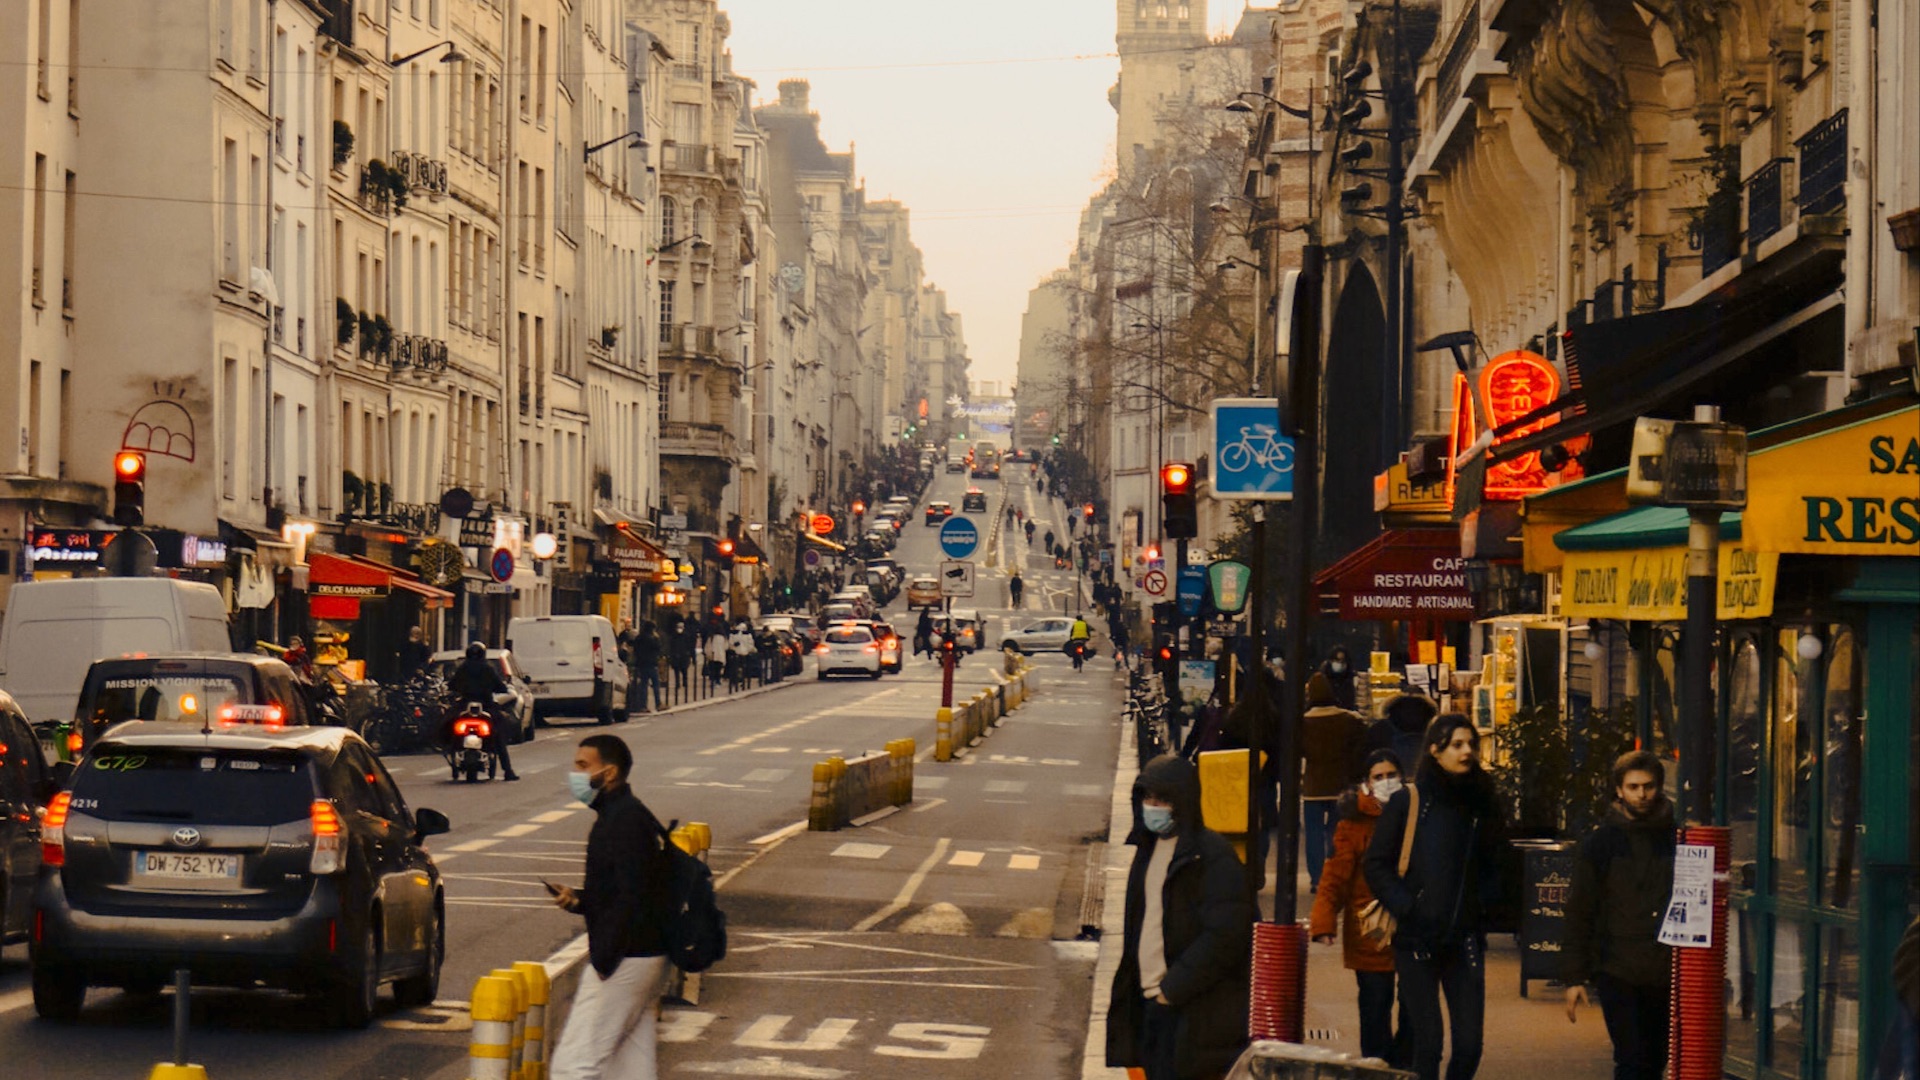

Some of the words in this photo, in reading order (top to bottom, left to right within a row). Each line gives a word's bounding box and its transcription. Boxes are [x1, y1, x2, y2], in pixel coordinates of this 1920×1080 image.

[1870, 436, 1920, 474] SA
[1801, 496, 1920, 545] RES
[1432, 557, 1468, 571] CAF
[1374, 574, 1466, 587] RESTAURAN
[345, 586, 377, 595] MARKET
[1353, 595, 1412, 608] HANDMADE
[1416, 596, 1474, 609] ARTISANAL
[105, 679, 158, 689] MISSION
[159, 677, 233, 688] VIGIPIRATE
[70, 799, 98, 809] 4214
[147, 856, 227, 874] DW-752-YX
